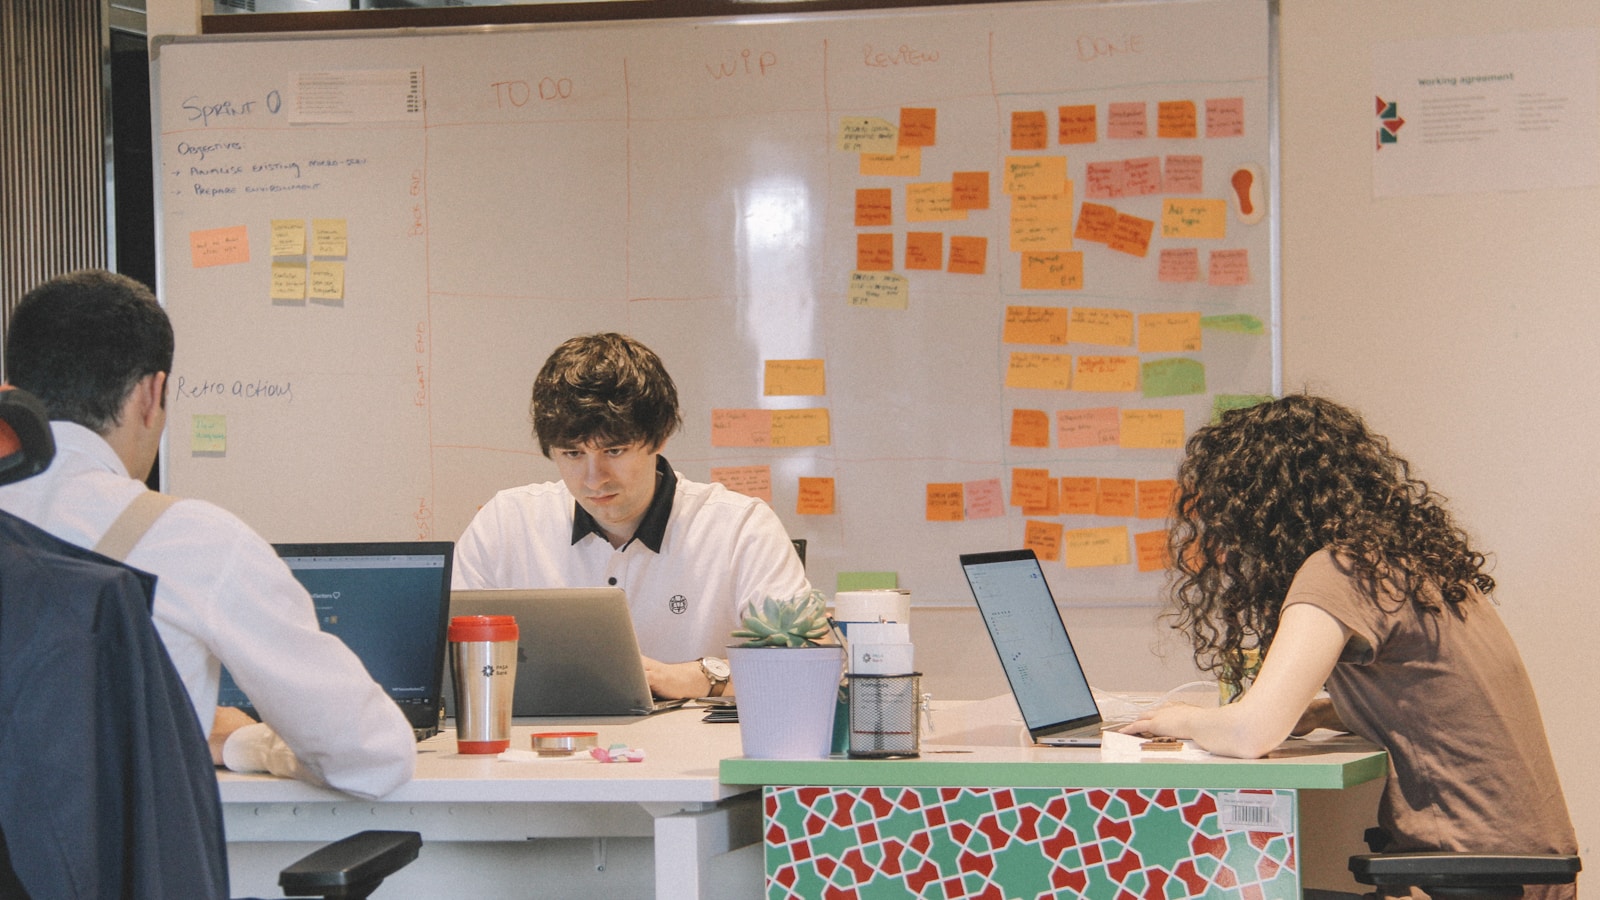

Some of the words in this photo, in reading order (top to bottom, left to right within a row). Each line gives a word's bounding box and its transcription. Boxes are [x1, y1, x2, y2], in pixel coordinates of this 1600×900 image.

[1418, 77, 1456, 86] Working
[1460, 72, 1513, 85] agreement
[266, 90, 281, 114] 0
[175, 375, 225, 402] Retro
[231, 379, 294, 403] actions
